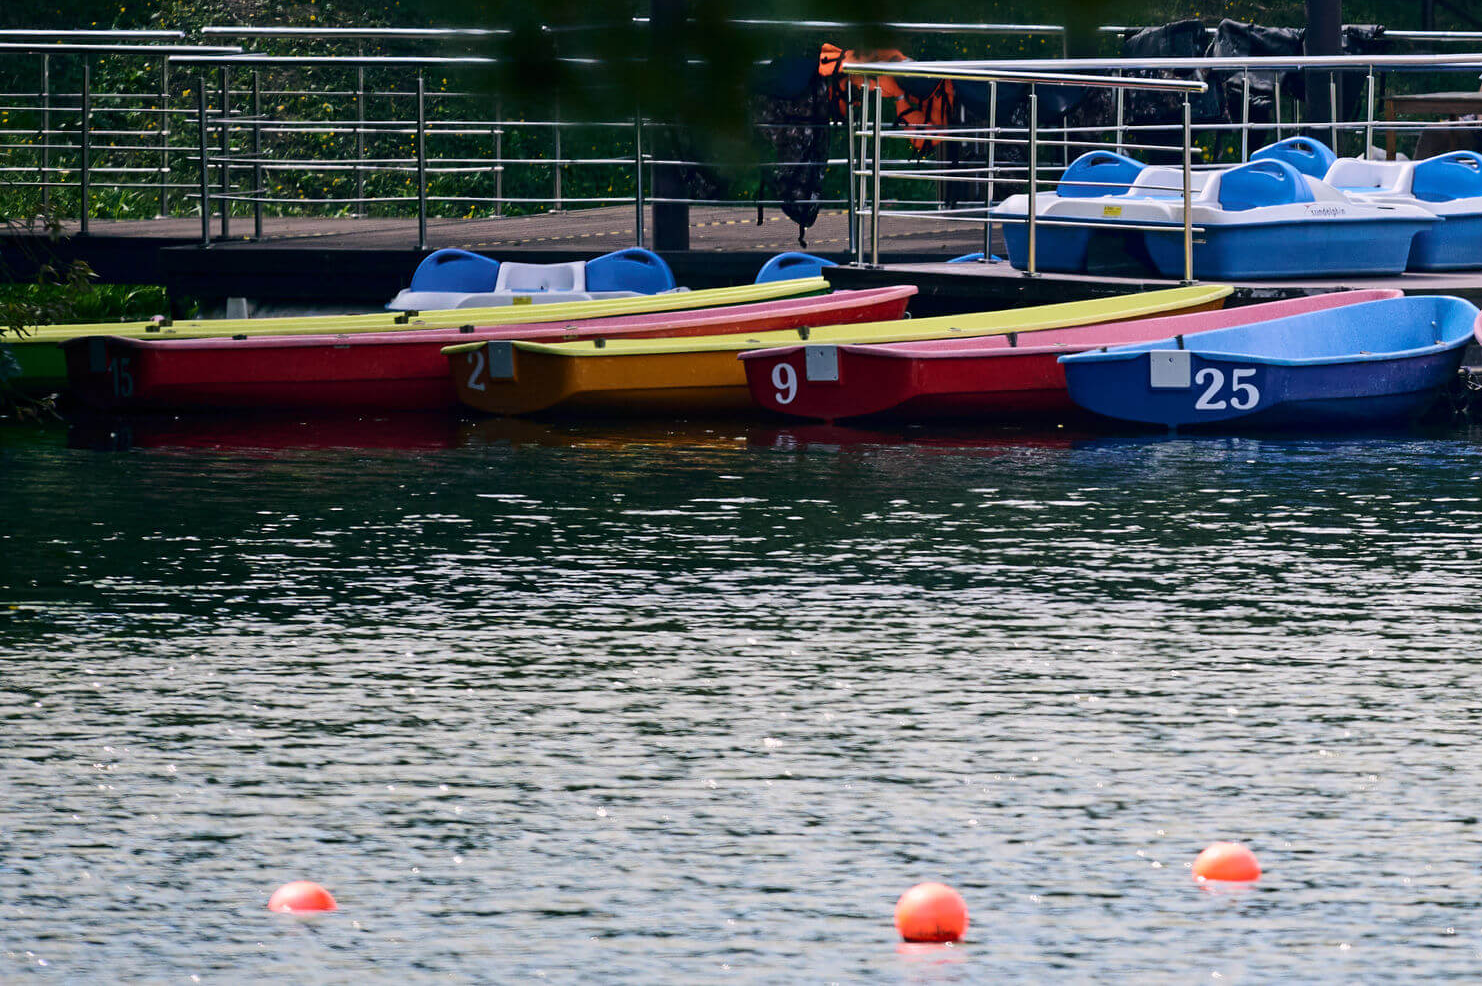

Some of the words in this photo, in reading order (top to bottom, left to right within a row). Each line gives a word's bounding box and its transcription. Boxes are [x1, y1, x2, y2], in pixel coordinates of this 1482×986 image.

[110, 357, 134, 399] 15
[467, 351, 486, 391] 2
[771, 362, 798, 405] 9
[1195, 367, 1260, 410] 25
